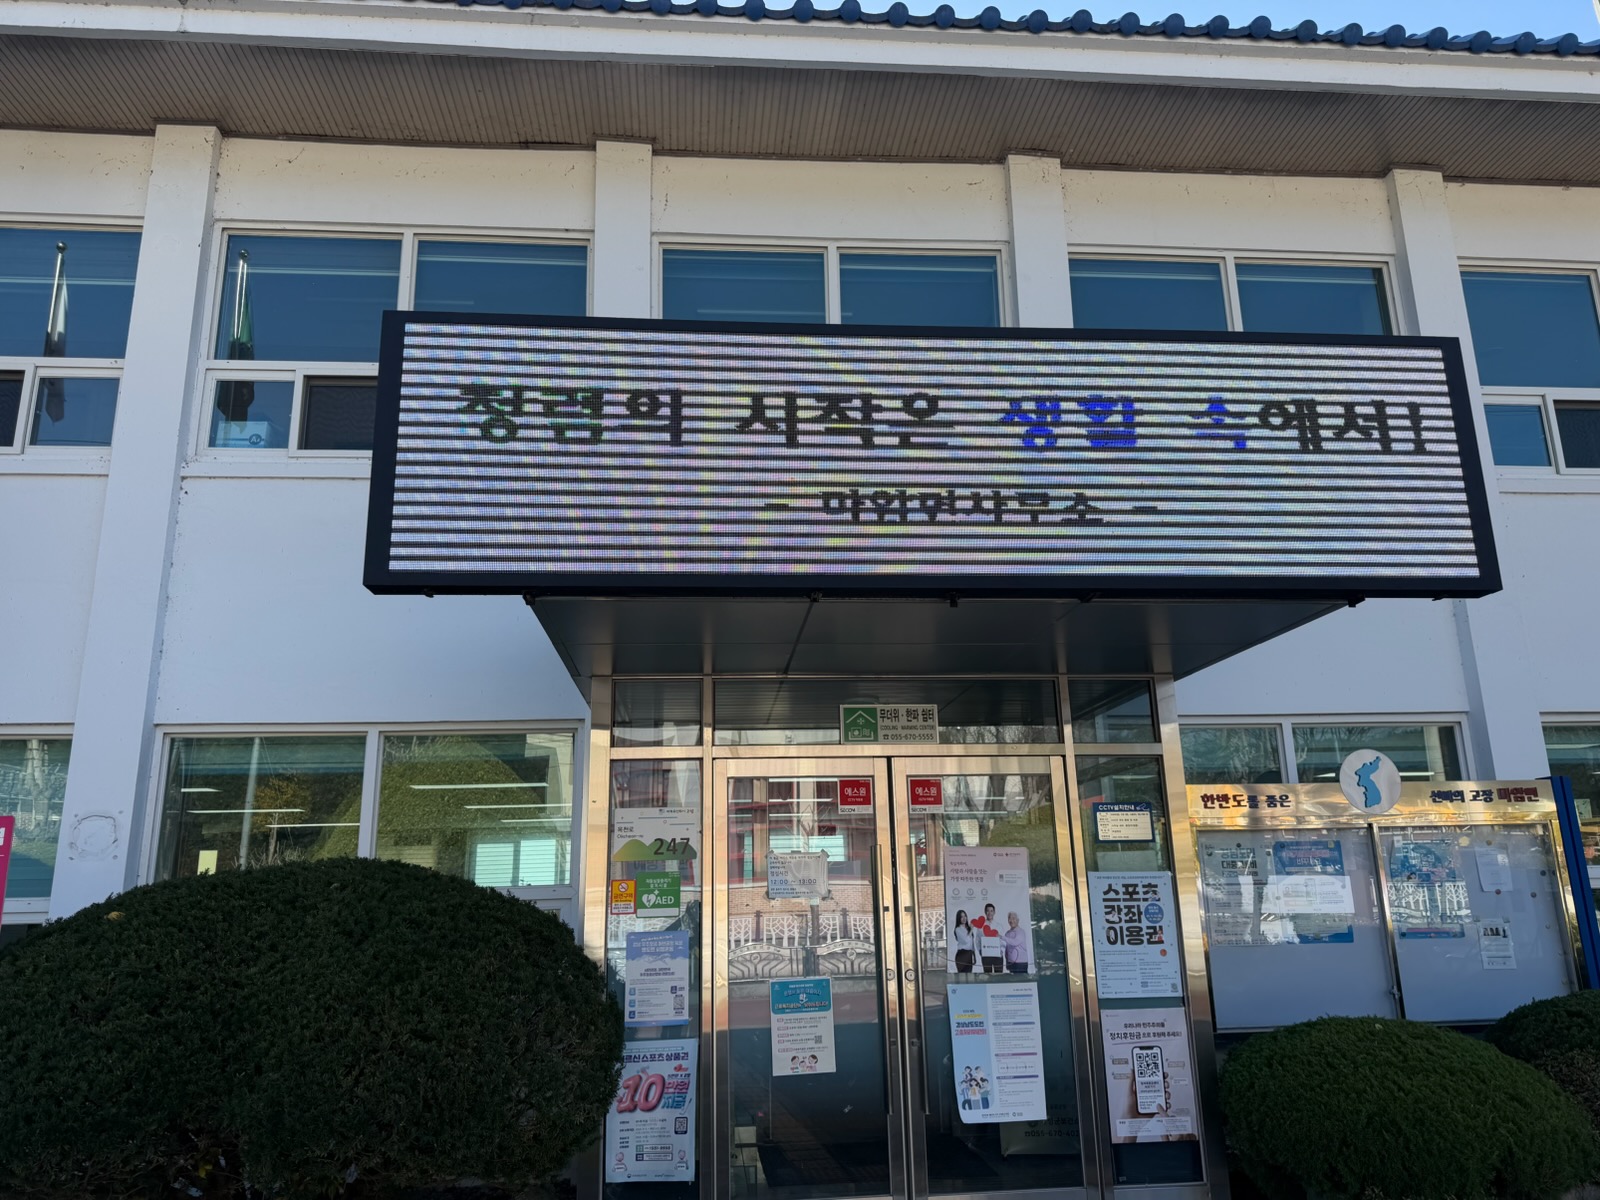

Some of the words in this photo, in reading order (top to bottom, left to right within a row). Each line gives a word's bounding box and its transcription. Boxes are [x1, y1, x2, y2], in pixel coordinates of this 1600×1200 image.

[459, 384, 683, 447] 청렴의
[735, 391, 955, 450] 시작은
[1001, 395, 1137, 448] 생활
[819, 488, 1106, 523] 마암면사무소
[879, 708, 900, 723] 무더위
[905, 708, 919, 722] 한파
[921, 708, 935, 722] 쉼터
[844, 787, 866, 796] 에스원
[915, 787, 937, 796] 에스원
[1469, 789, 1494, 803] 고장
[1496, 787, 1539, 802] 마암면
[1200, 793, 1260, 809] 한반도를
[1265, 794, 1291, 808] 품은
[653, 837, 690, 855] 247
[655, 896, 674, 904] AED
[1102, 883, 1161, 902] 스포츠
[1104, 904, 1143, 924] 강좌
[1106, 926, 1164, 945] 이용권
[616, 1073, 665, 1113] 10
